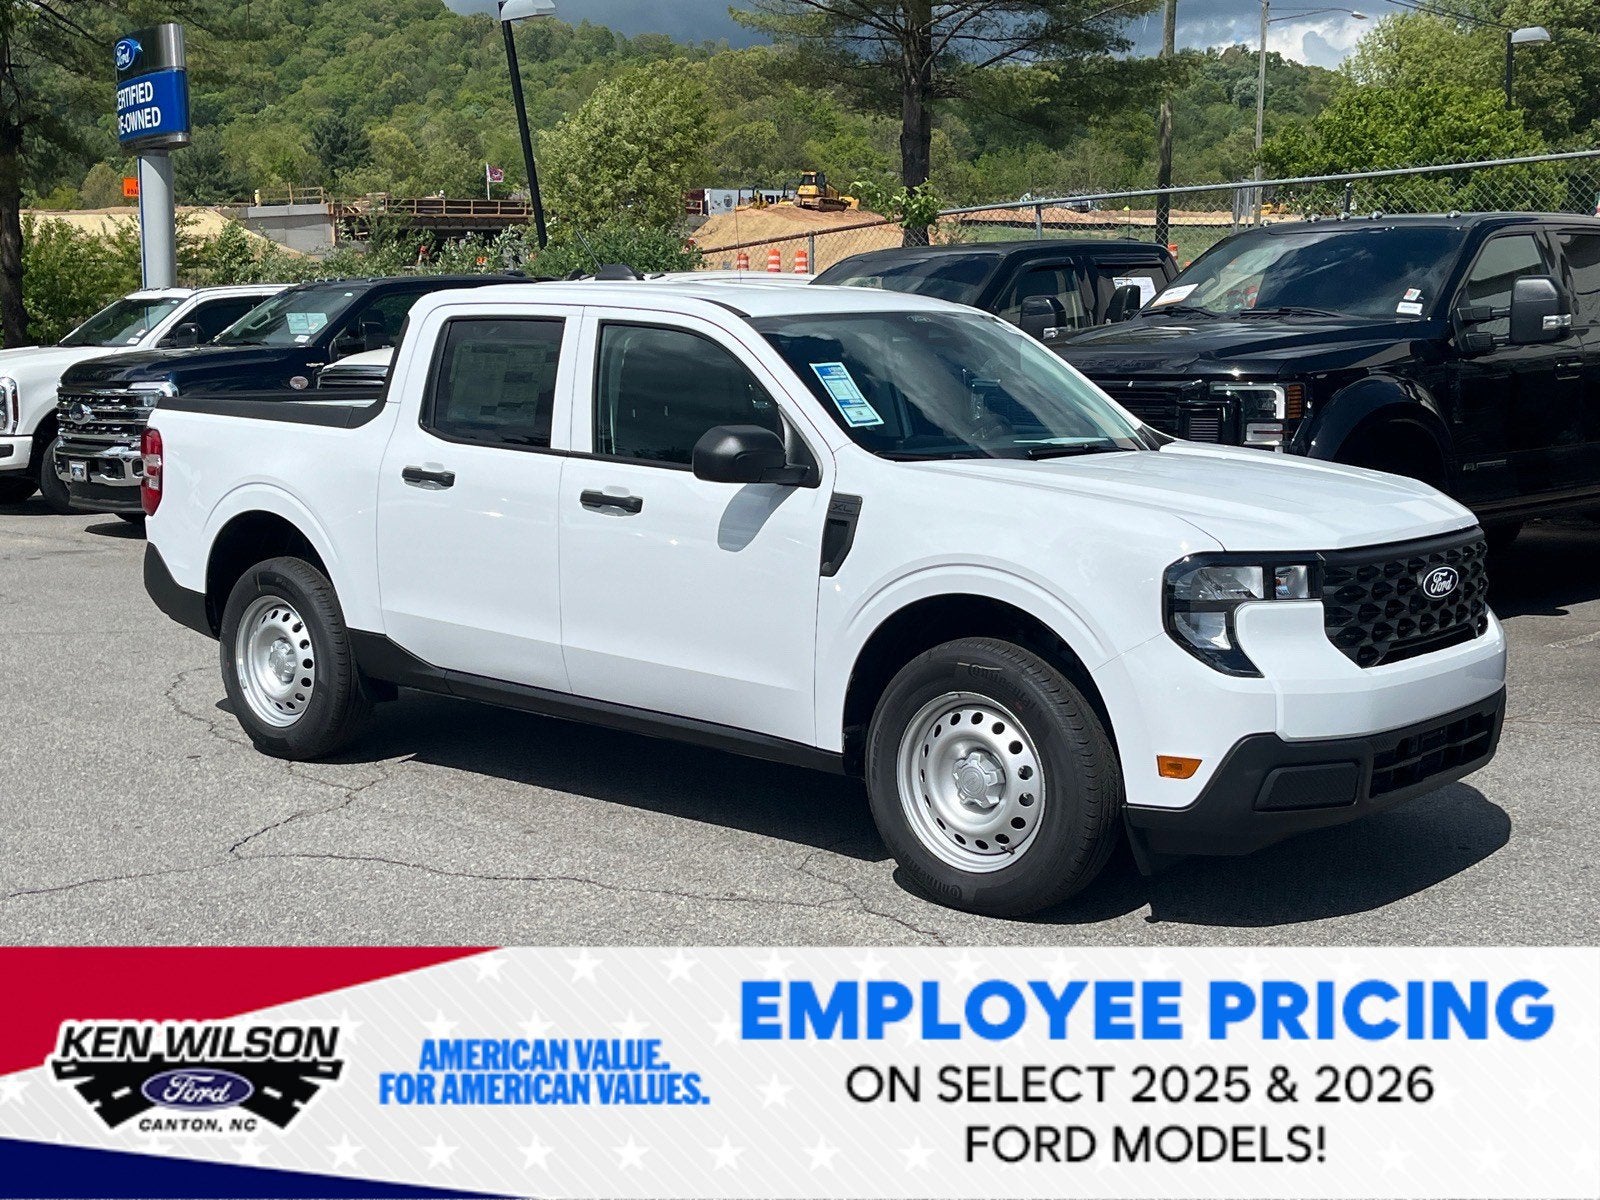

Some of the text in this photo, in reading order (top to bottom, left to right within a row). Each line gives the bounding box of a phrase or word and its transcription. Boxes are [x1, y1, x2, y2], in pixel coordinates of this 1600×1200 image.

[117, 81, 154, 110] ERTIFIED
[118, 106, 162, 135] E-OWNED
[832, 503, 853, 513] XL
[1430, 571, 1454, 594] Ford
